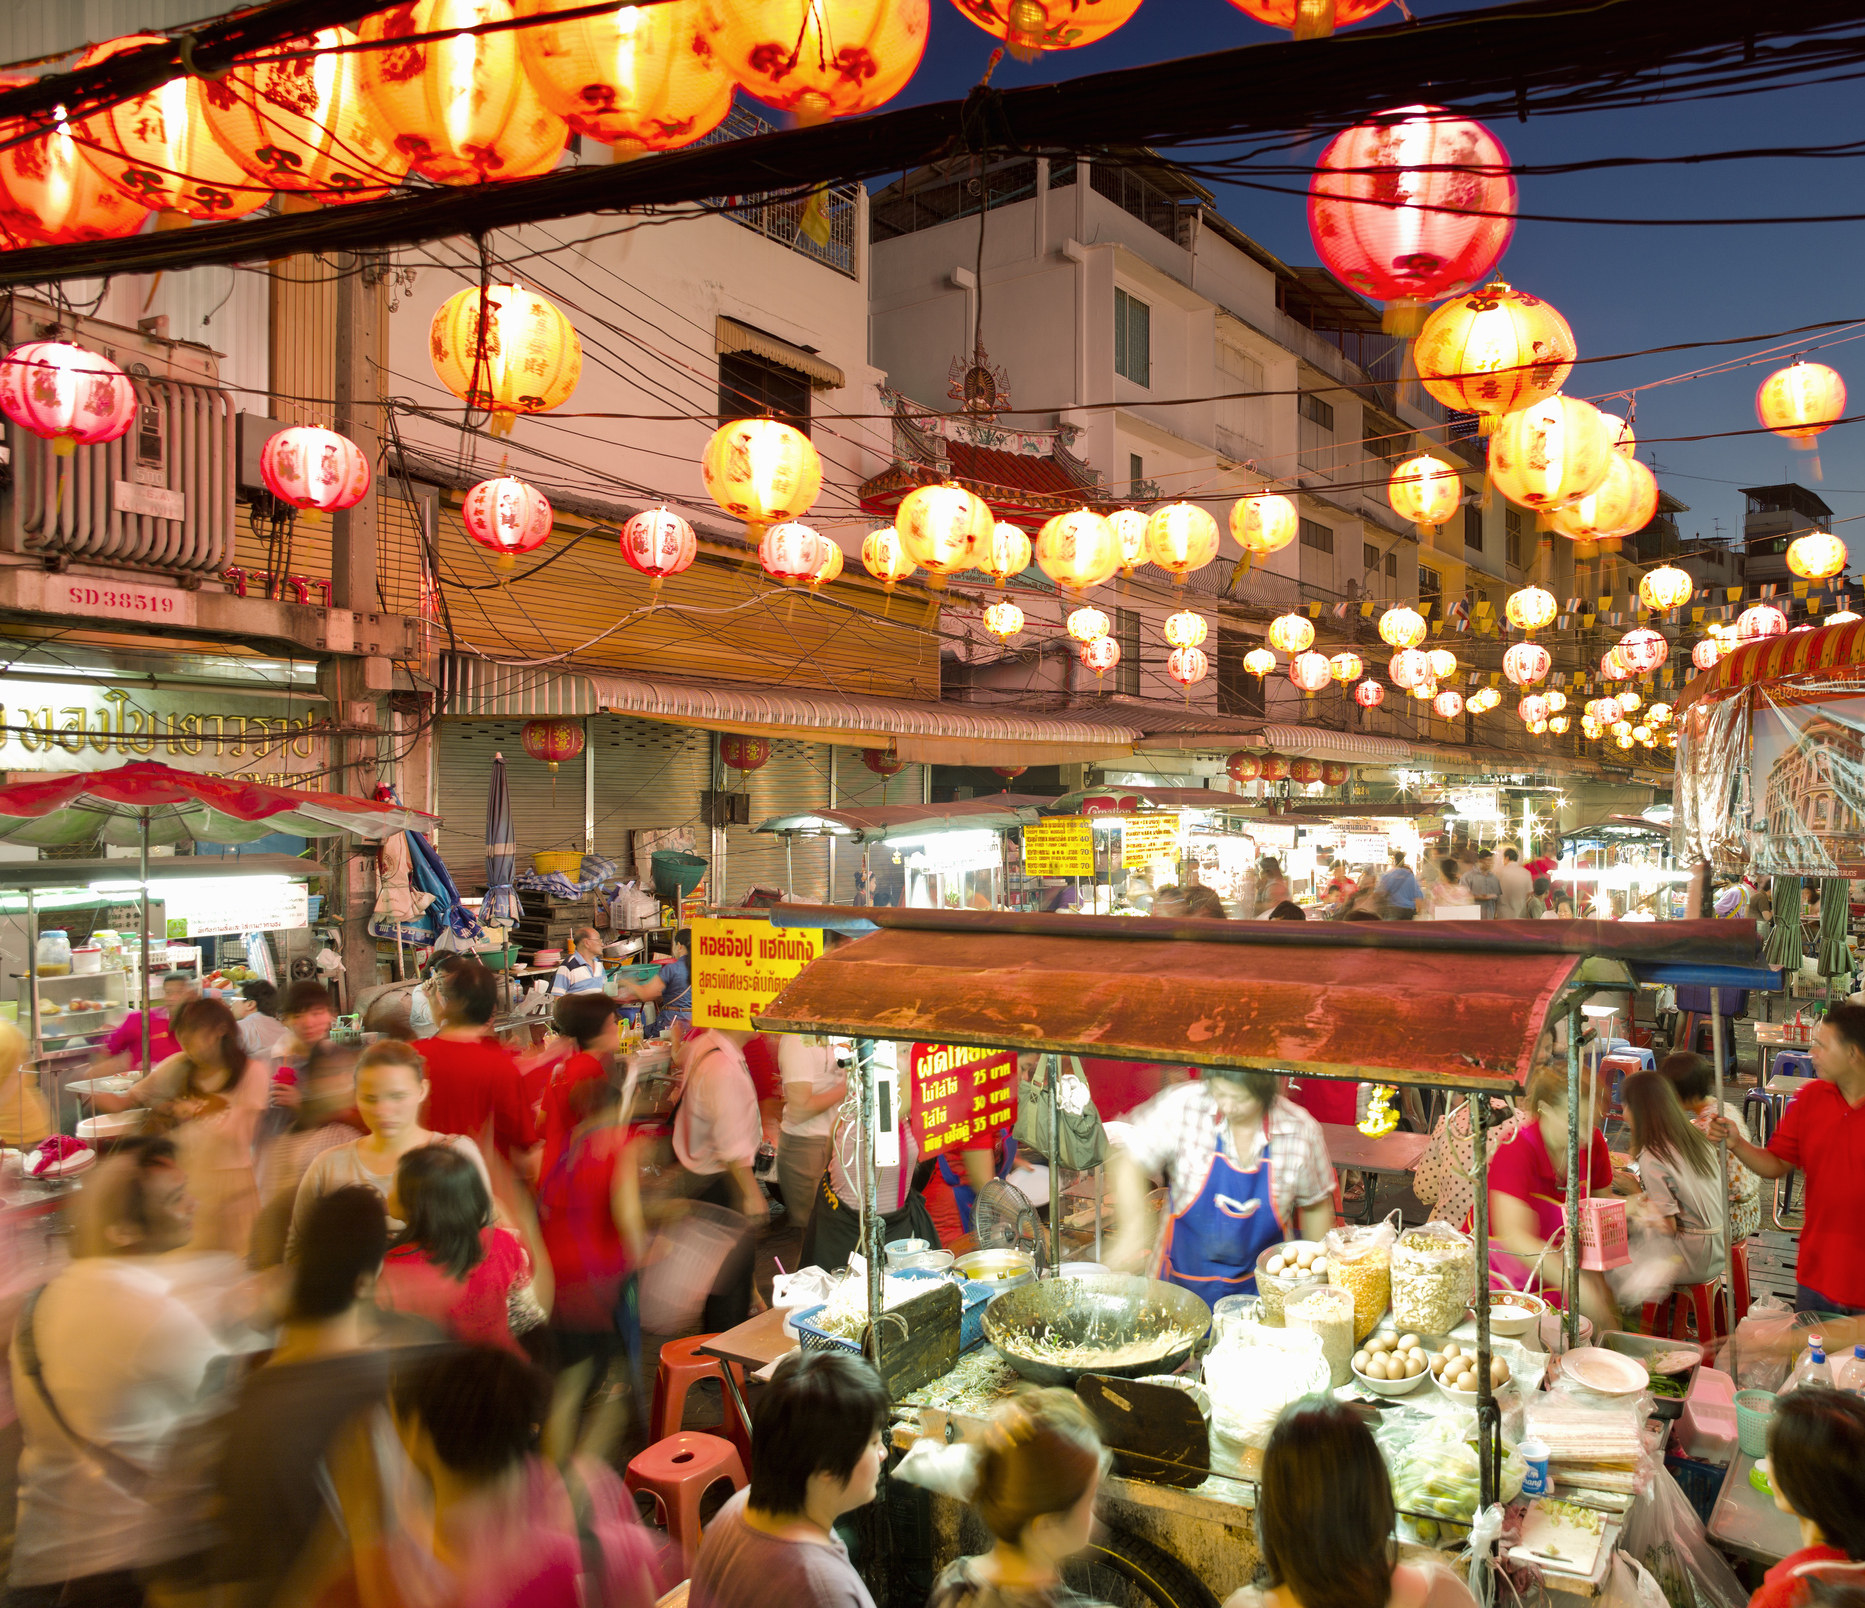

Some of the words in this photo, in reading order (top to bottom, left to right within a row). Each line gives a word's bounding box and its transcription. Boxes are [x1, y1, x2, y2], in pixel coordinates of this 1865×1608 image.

[68, 587, 174, 613] SD38519
[750, 1003, 770, 1017] 5
[972, 1068, 987, 1087] 25
[990, 1062, 1011, 1080] บาท
[972, 1094, 986, 1112] 30
[989, 1087, 1011, 1104] บาท
[989, 1107, 1011, 1126] บาท
